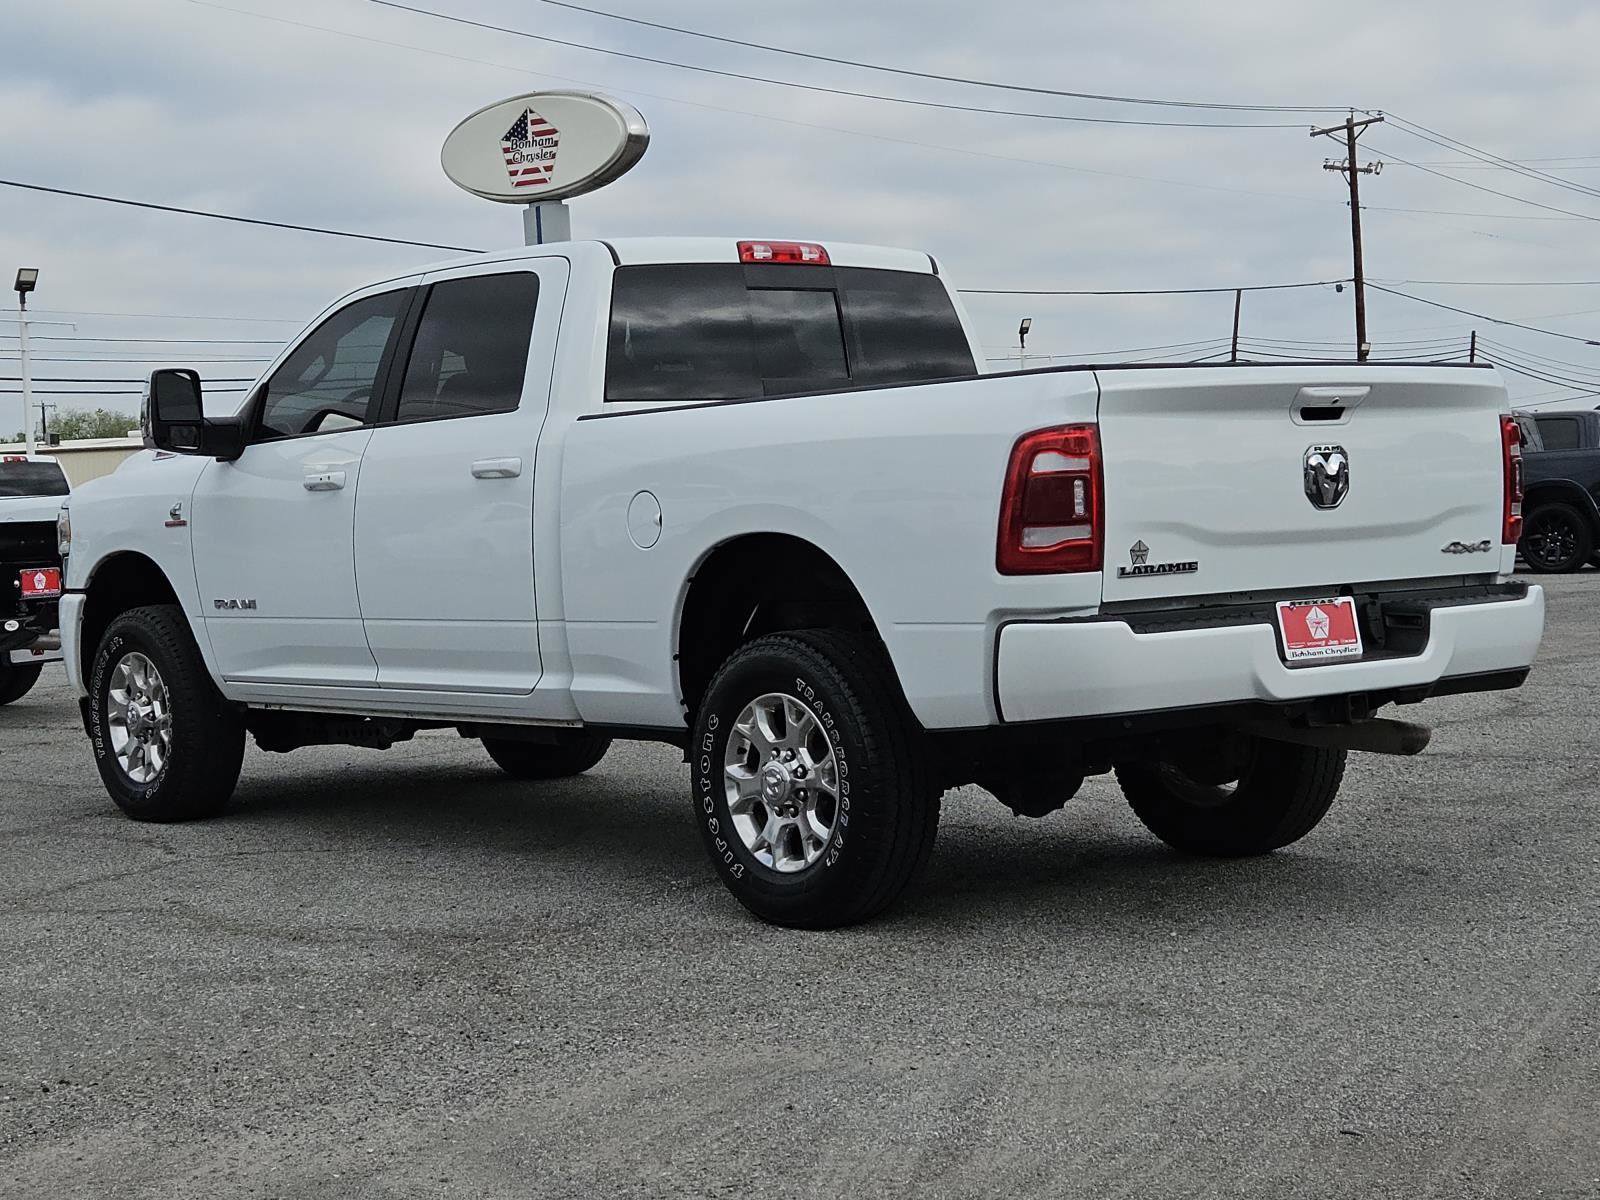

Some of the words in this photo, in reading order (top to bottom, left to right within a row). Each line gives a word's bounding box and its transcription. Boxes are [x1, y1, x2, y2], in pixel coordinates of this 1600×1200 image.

[510, 136, 554, 151] Bonham
[512, 148, 554, 162] Chrysler
[1117, 561, 1198, 578] LARAMIE
[213, 599, 257, 610] RAM
[1298, 598, 1334, 606] TEXAS
[1291, 649, 1324, 658] Bonham
[1325, 646, 1358, 655] Chrysler
[796, 677, 850, 827] TRANSFORCE
[700, 714, 745, 878] FIRESTONE
